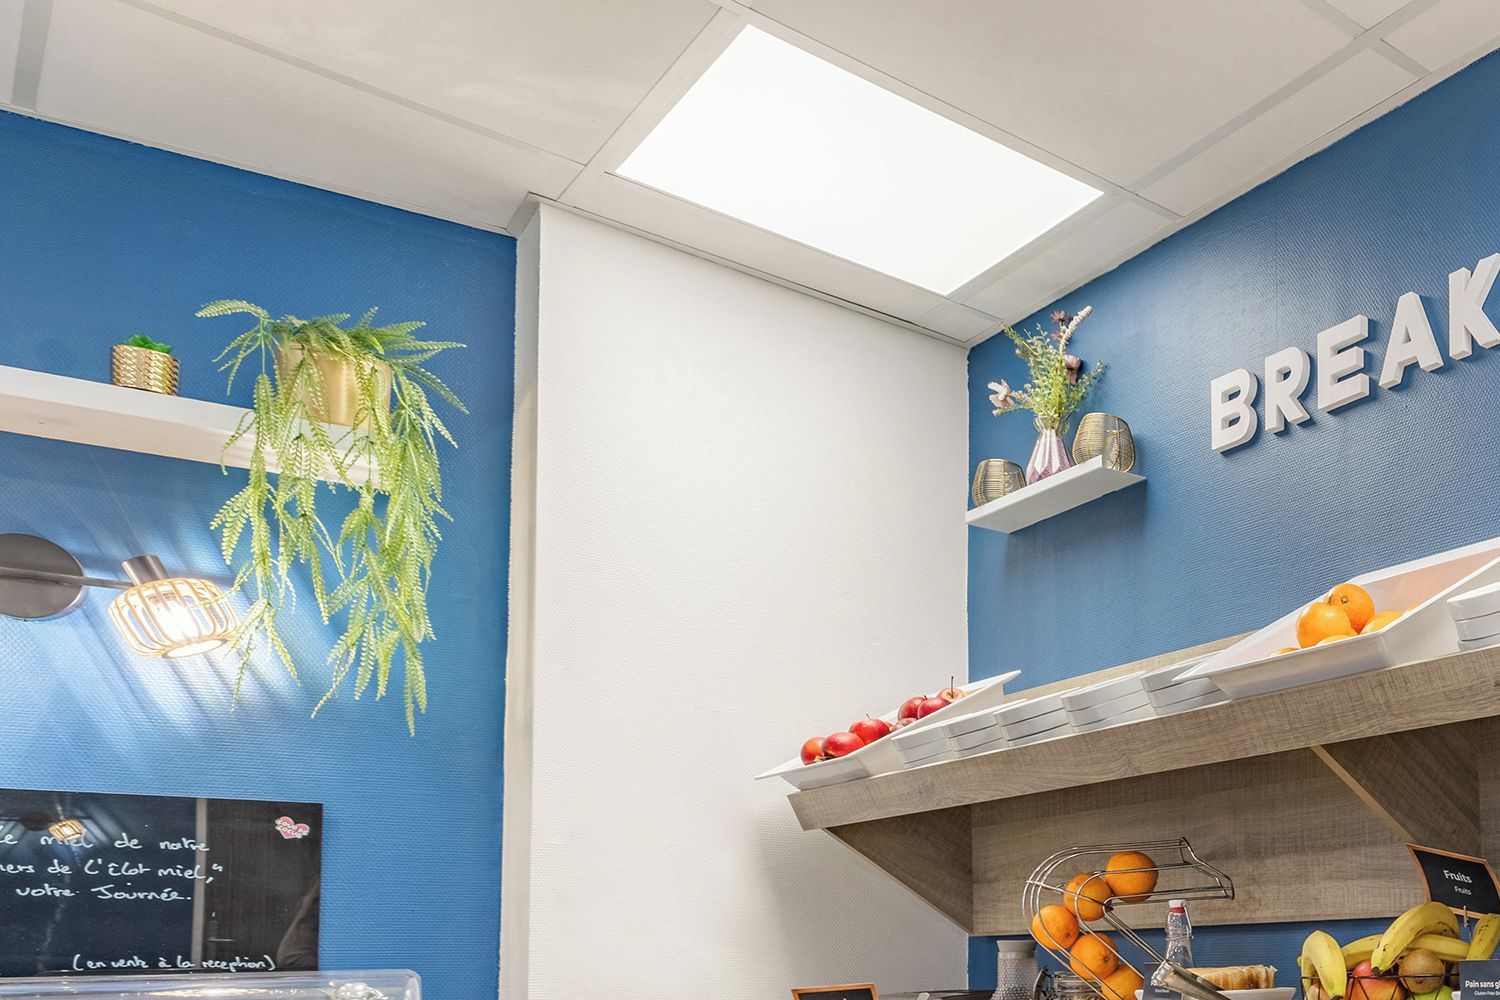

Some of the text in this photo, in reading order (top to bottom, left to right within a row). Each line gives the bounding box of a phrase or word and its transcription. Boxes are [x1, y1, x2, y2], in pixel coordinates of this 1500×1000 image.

[114, 832, 143, 849] de
[47, 859, 72, 875] de
[1443, 869, 1473, 884] Fruits
[15, 883, 77, 897] votre
[1454, 885, 1472, 896] Fruits
[158, 956, 172, 969] à
[176, 954, 196, 968] la
[1465, 980, 1480, 988] Pain
[1480, 980, 1494, 988] sans
